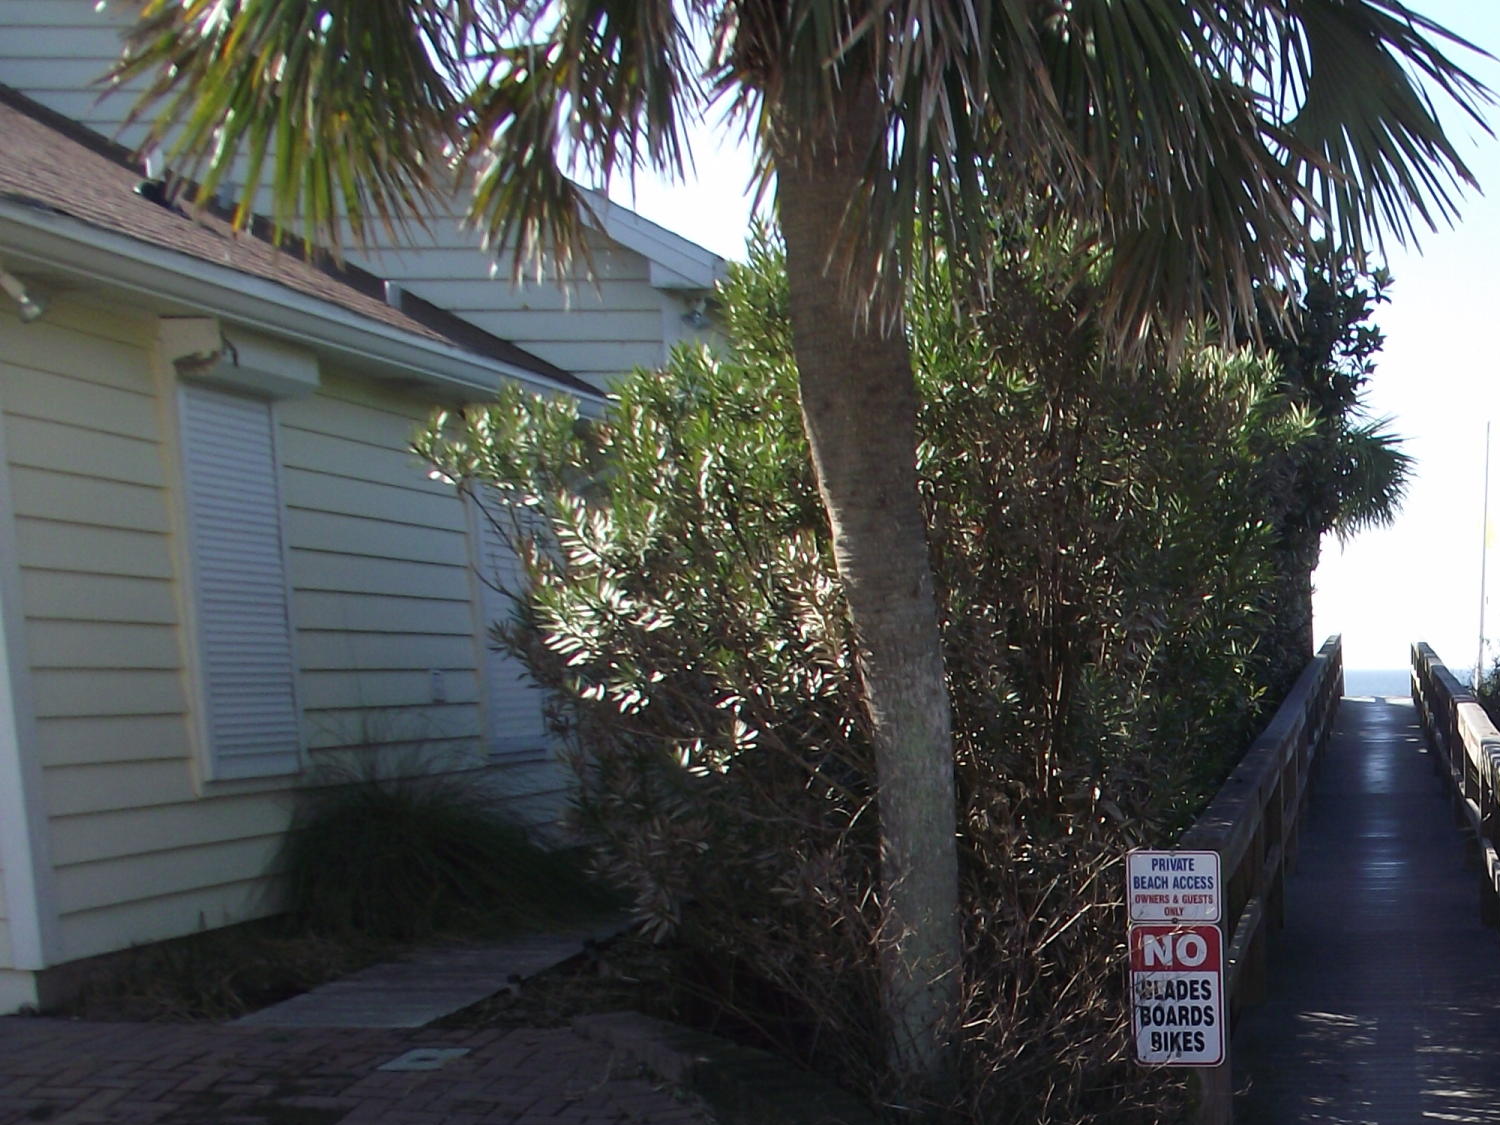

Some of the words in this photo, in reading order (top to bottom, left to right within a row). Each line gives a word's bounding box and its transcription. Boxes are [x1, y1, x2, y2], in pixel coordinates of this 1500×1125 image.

[1151, 858, 1195, 871] PRIVATE
[1133, 876, 1169, 889] BEACH
[1172, 876, 1214, 889] ACCESS
[1135, 894, 1169, 904] OWNERS
[1172, 894, 1179, 904] &
[1182, 894, 1213, 904] GUESTS
[1164, 907, 1184, 917] ONLY
[1143, 934, 1207, 967] NO
[1140, 980, 1212, 1000] BLADES
[1140, 1005, 1215, 1027] BOARDS
[1151, 1031, 1205, 1052] BIKES
